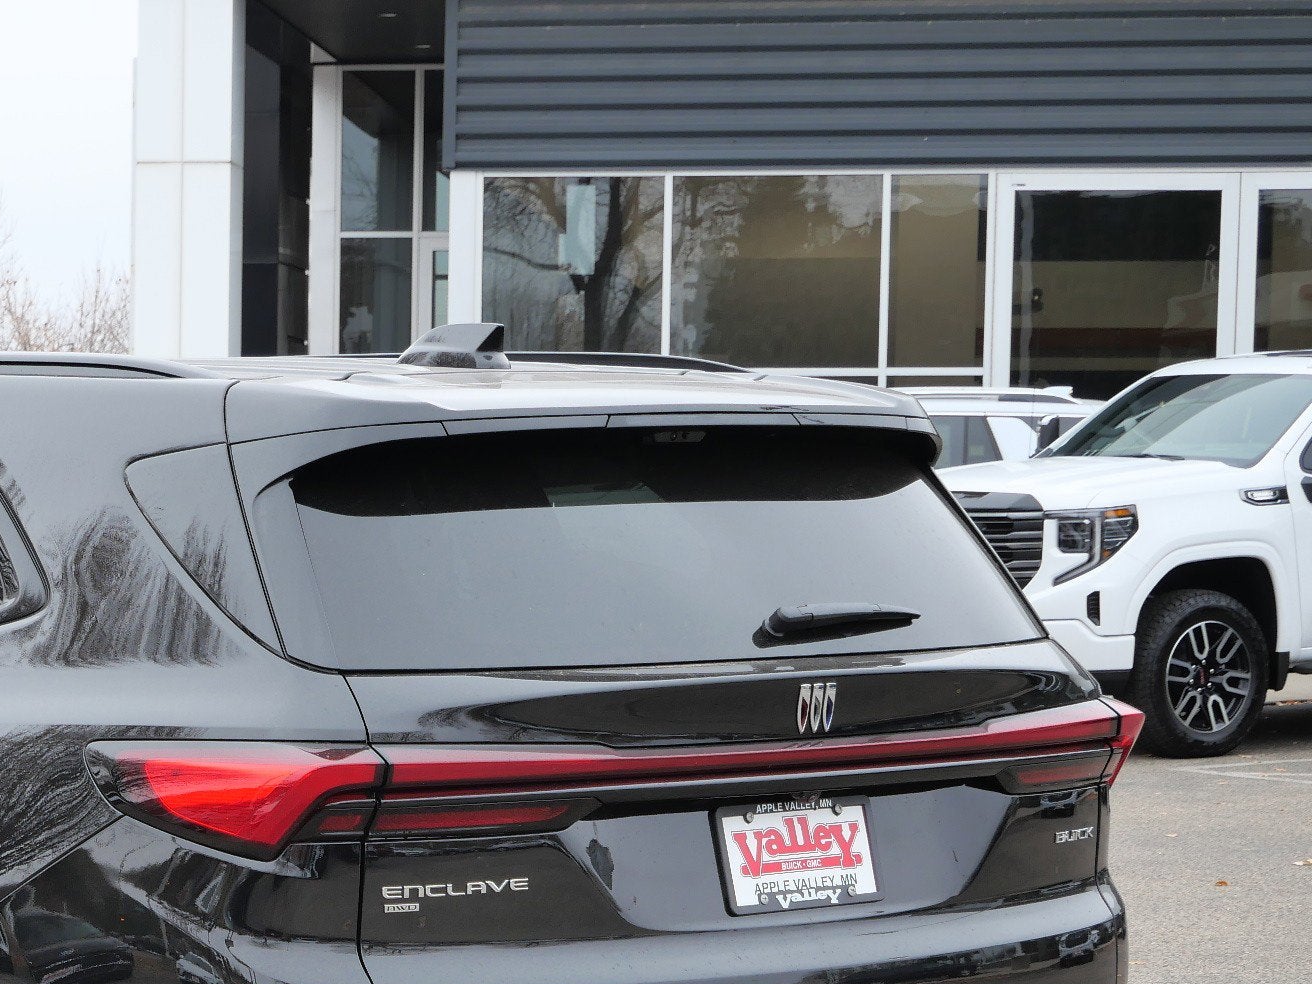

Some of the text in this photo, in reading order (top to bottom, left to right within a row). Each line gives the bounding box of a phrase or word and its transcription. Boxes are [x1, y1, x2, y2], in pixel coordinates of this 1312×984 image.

[756, 802, 784, 814] APPLE
[819, 798, 833, 808] MN
[1055, 826, 1094, 843] BUICK
[781, 859, 822, 870] BUICK GMC
[381, 877, 529, 899] ENCLAVE
[755, 880, 790, 894] APPLE
[840, 873, 858, 886] MN
